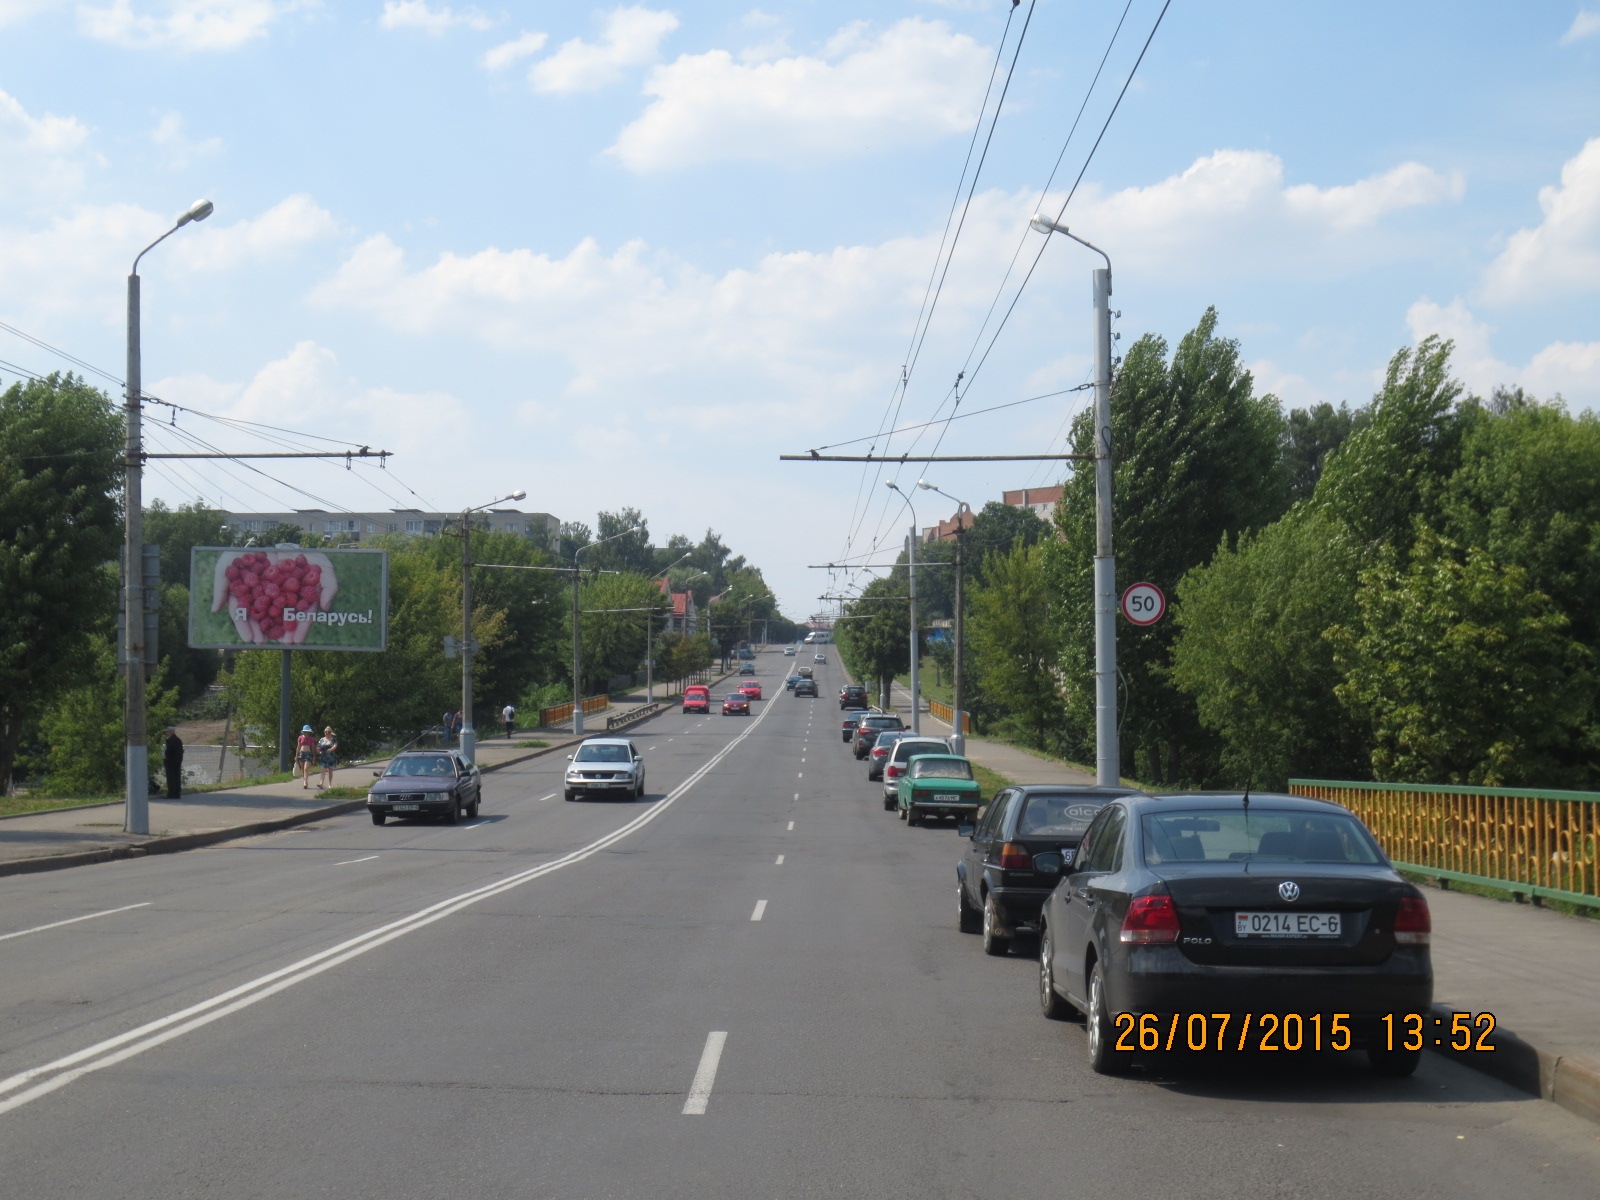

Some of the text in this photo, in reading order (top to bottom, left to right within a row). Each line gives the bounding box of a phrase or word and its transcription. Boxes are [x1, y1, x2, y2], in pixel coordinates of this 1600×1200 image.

[1132, 595, 1155, 612] 50
[234, 607, 373, 626] Я Беларусь!
[1251, 914, 1339, 933] 0214 EC-6
[1183, 937, 1212, 945] POLO
